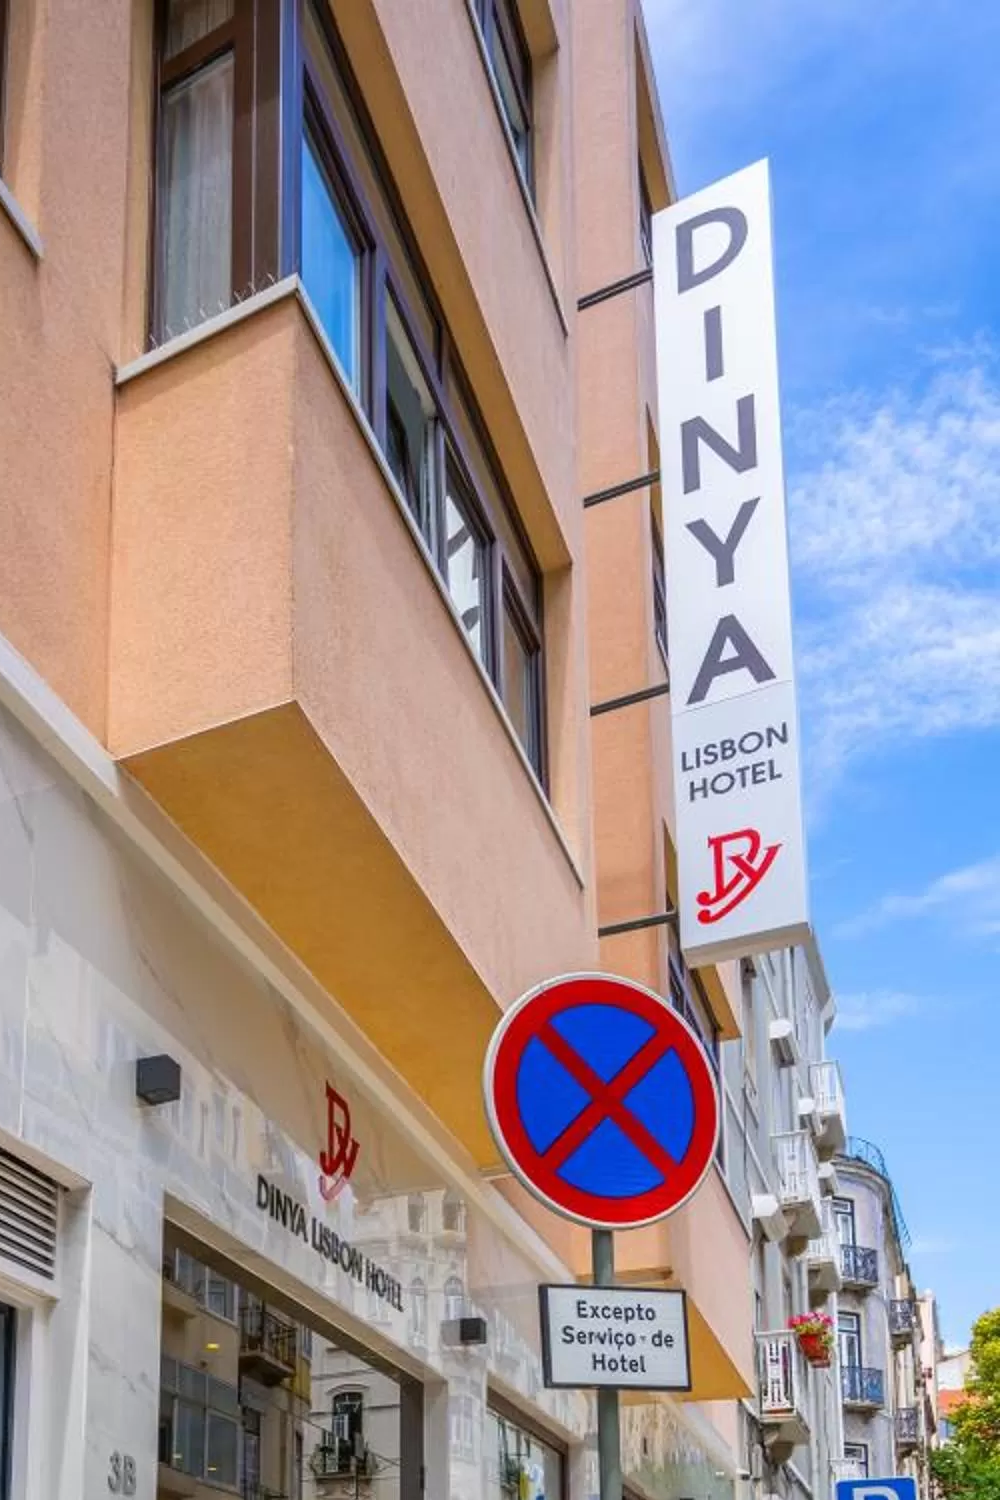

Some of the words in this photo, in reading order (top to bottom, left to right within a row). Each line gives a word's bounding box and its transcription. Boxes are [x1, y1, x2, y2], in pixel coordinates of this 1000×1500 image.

[675, 207, 776, 706] DINYA
[681, 721, 789, 773] LISBON
[688, 760, 783, 802] HOTEL
[256, 1173, 308, 1243] DINYA
[311, 1216, 363, 1283] LISBON
[365, 1257, 404, 1313] HOTEL
[576, 1300, 656, 1322] Excepto
[562, 1326, 636, 1349] Serviço
[651, 1330, 674, 1348] de
[591, 1353, 646, 1373] Hotel
